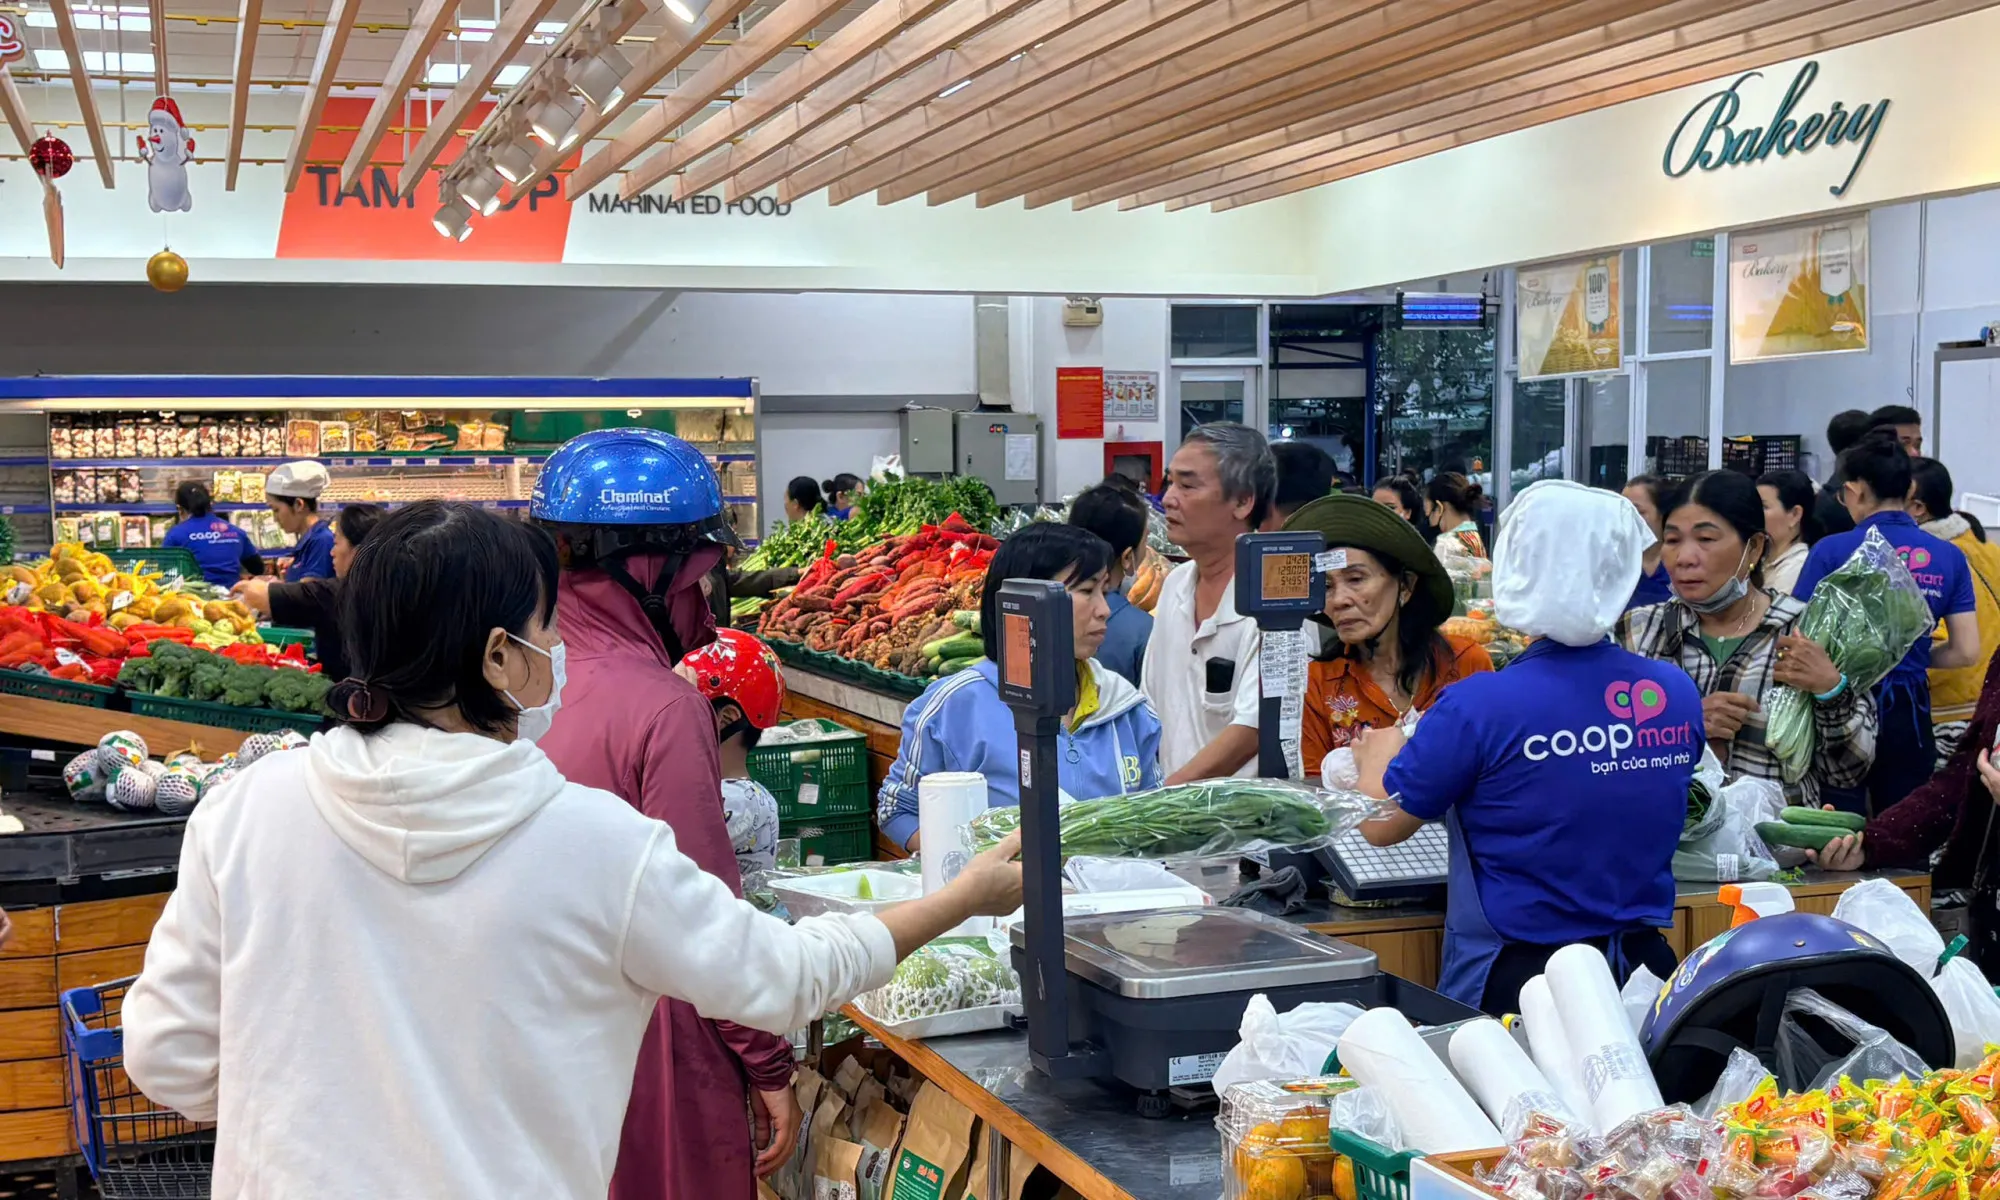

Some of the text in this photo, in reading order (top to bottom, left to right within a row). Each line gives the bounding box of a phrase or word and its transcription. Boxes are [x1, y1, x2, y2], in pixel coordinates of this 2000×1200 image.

[1663, 61, 1891, 196] Bakery
[1523, 721, 1691, 761] co.op mart
[1591, 761, 1618, 775] bạn
[1621, 756, 1647, 770] của
[1651, 753, 1672, 769] mọi
